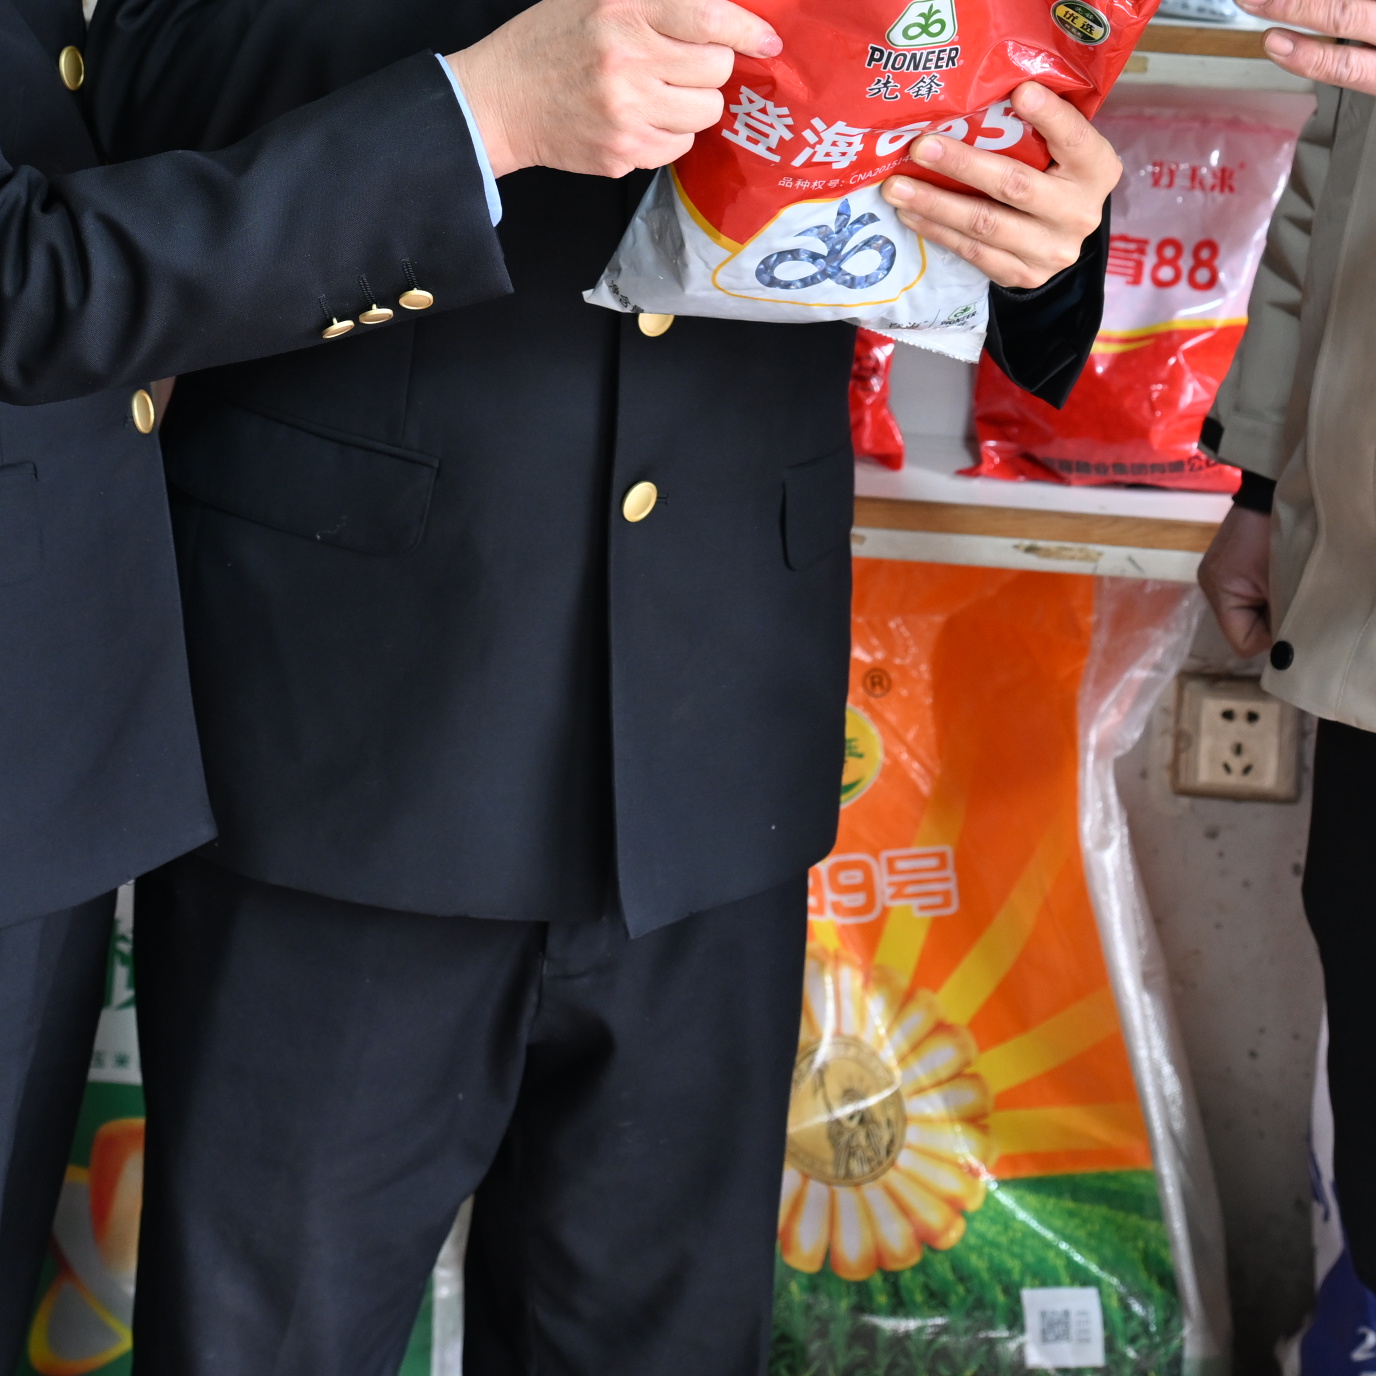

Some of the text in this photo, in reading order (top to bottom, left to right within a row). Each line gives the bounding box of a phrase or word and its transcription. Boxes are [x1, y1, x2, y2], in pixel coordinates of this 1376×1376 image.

[1062, 9, 1096, 36] 优选
[865, 44, 960, 72] PIONEER
[865, 73, 945, 102] 先锋
[849, 154, 915, 185] CNA201514
